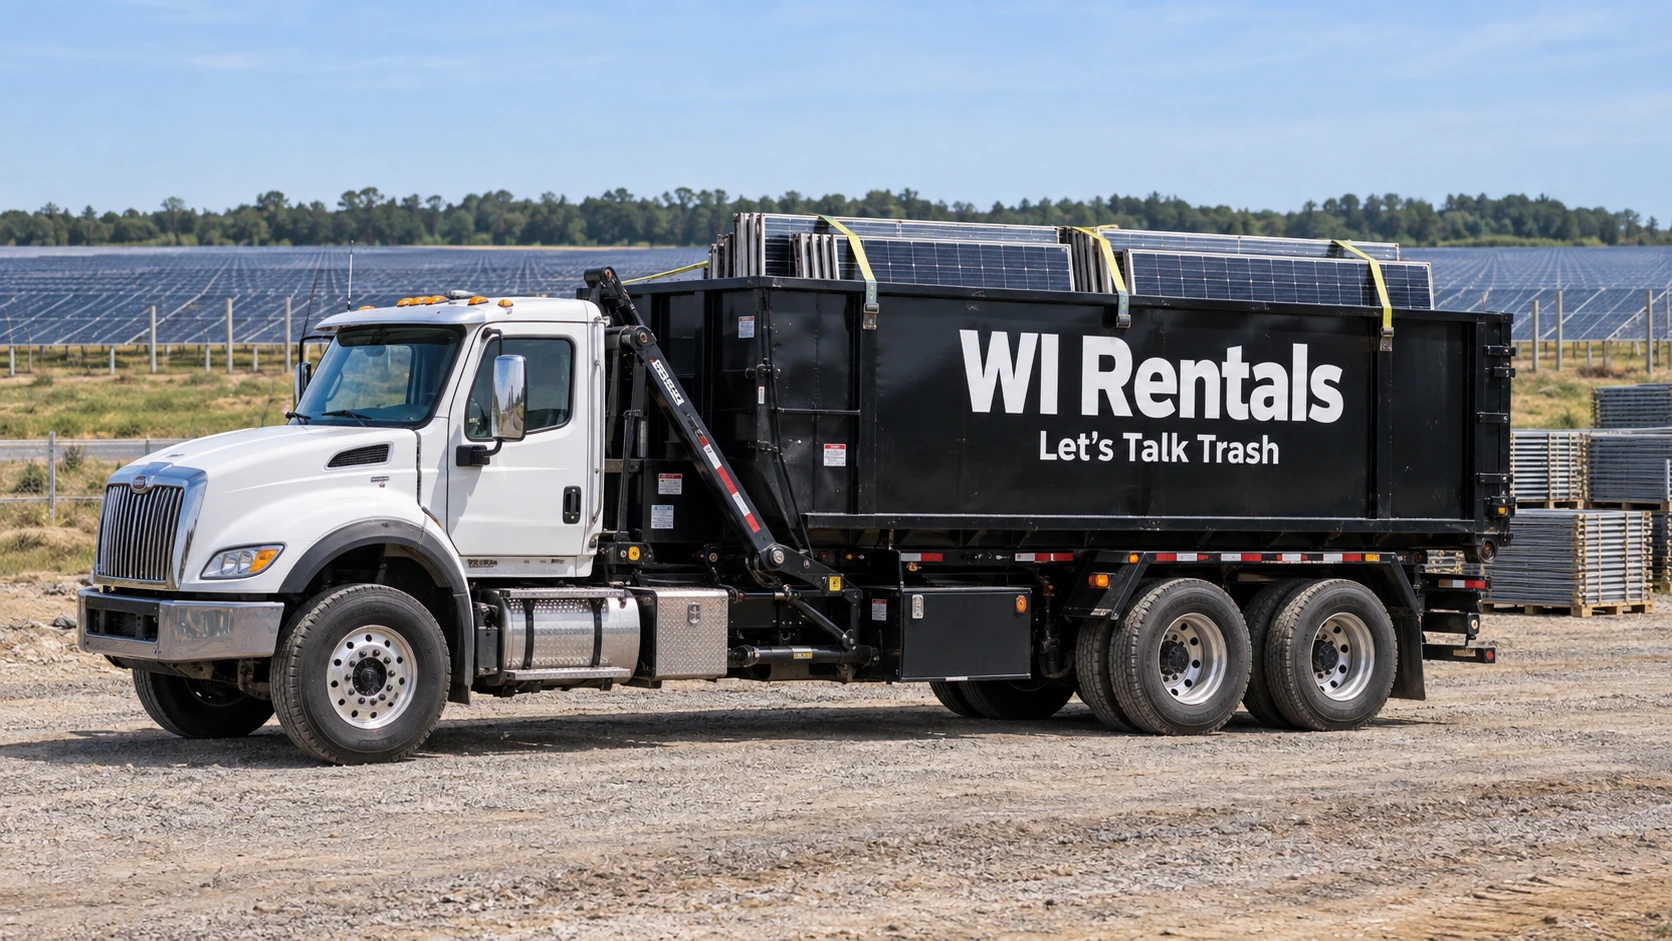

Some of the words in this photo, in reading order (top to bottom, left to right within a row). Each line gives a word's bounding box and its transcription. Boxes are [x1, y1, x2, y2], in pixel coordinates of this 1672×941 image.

[959, 329, 1060, 415] WI
[1081, 334, 1344, 424] Rentals
[1039, 430, 1114, 462] Let's
[1122, 431, 1190, 463] Talk
[1196, 433, 1279, 465] Trash
